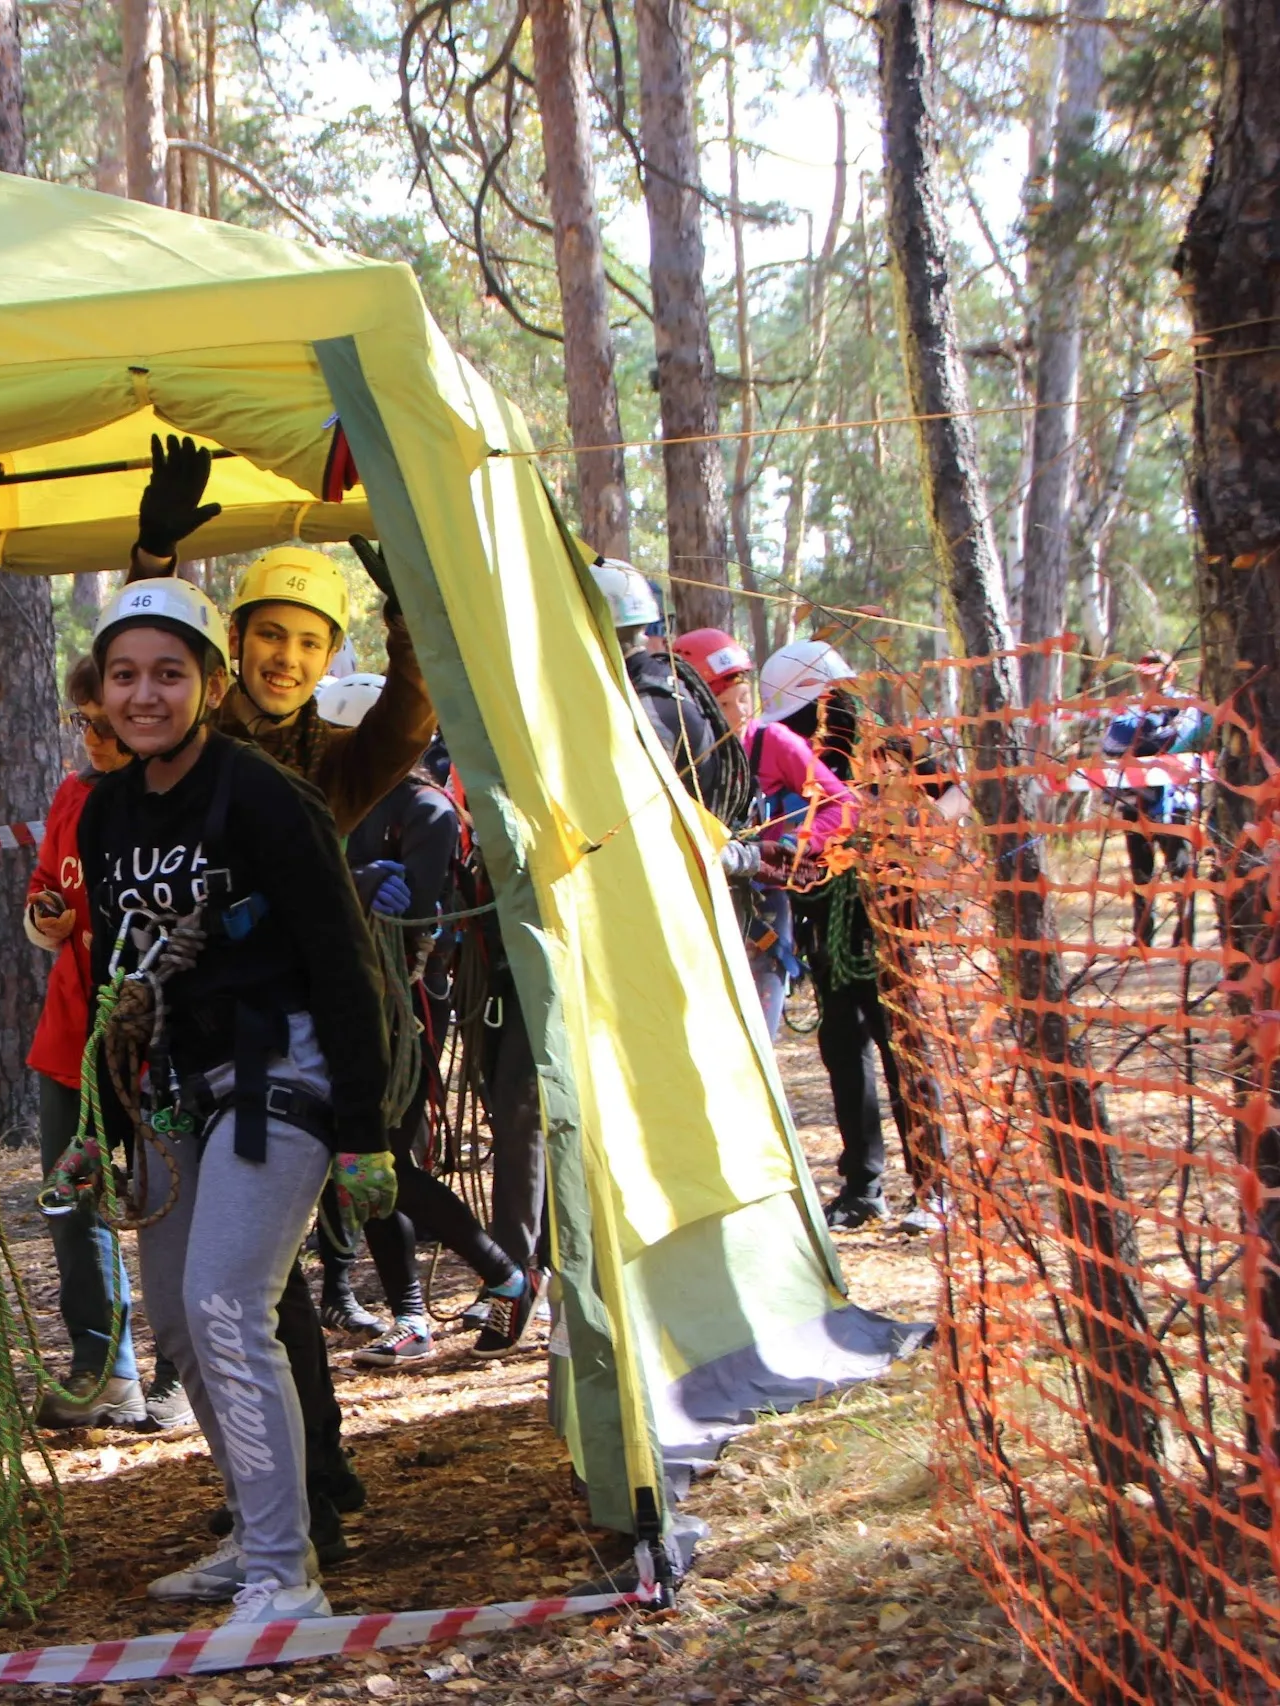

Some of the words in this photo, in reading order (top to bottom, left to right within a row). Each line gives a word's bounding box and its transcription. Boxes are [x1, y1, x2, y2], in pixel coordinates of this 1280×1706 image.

[286, 575, 307, 591] 46
[130, 595, 152, 608] 46
[200, 1294, 275, 1477] Warrior
